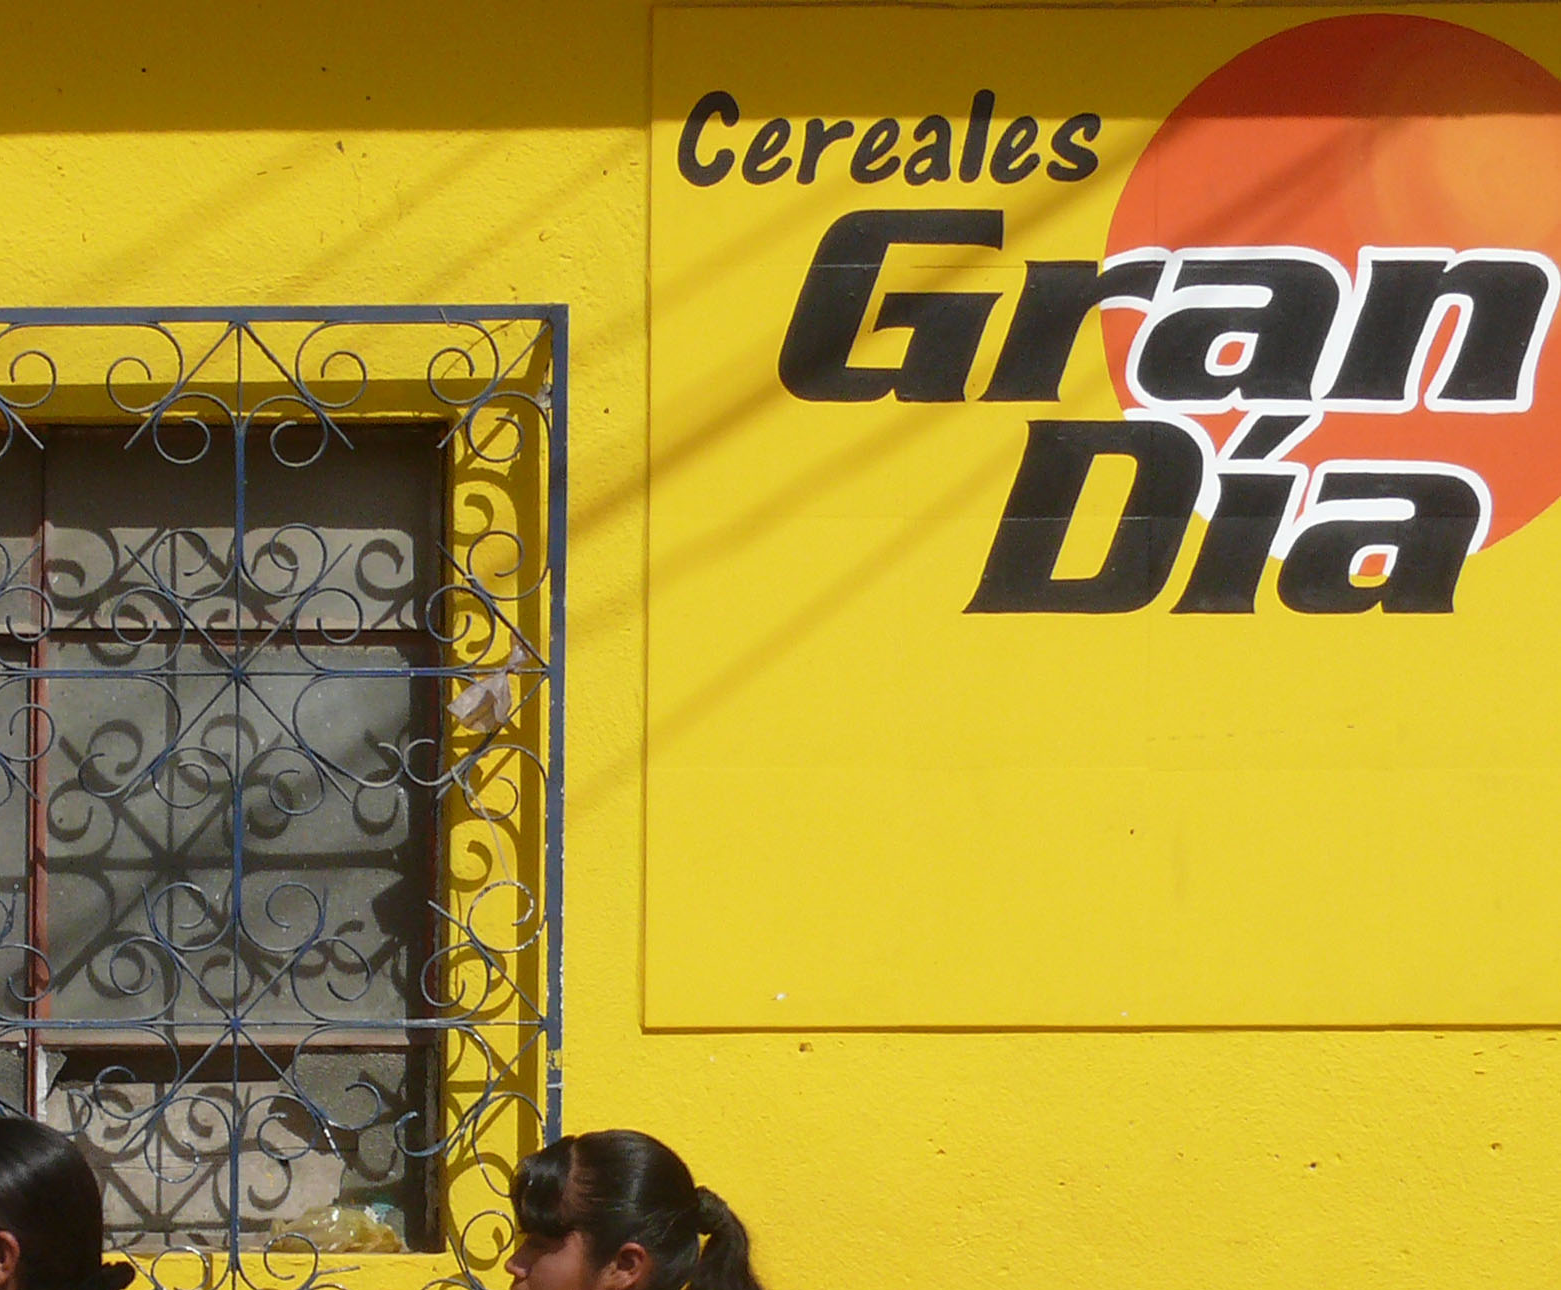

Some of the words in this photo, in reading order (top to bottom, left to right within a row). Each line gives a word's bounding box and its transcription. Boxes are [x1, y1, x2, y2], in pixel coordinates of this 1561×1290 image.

[677, 88, 1102, 188] Cereales
[777, 208, 1554, 408] Gran
[961, 411, 1488, 615] Día
